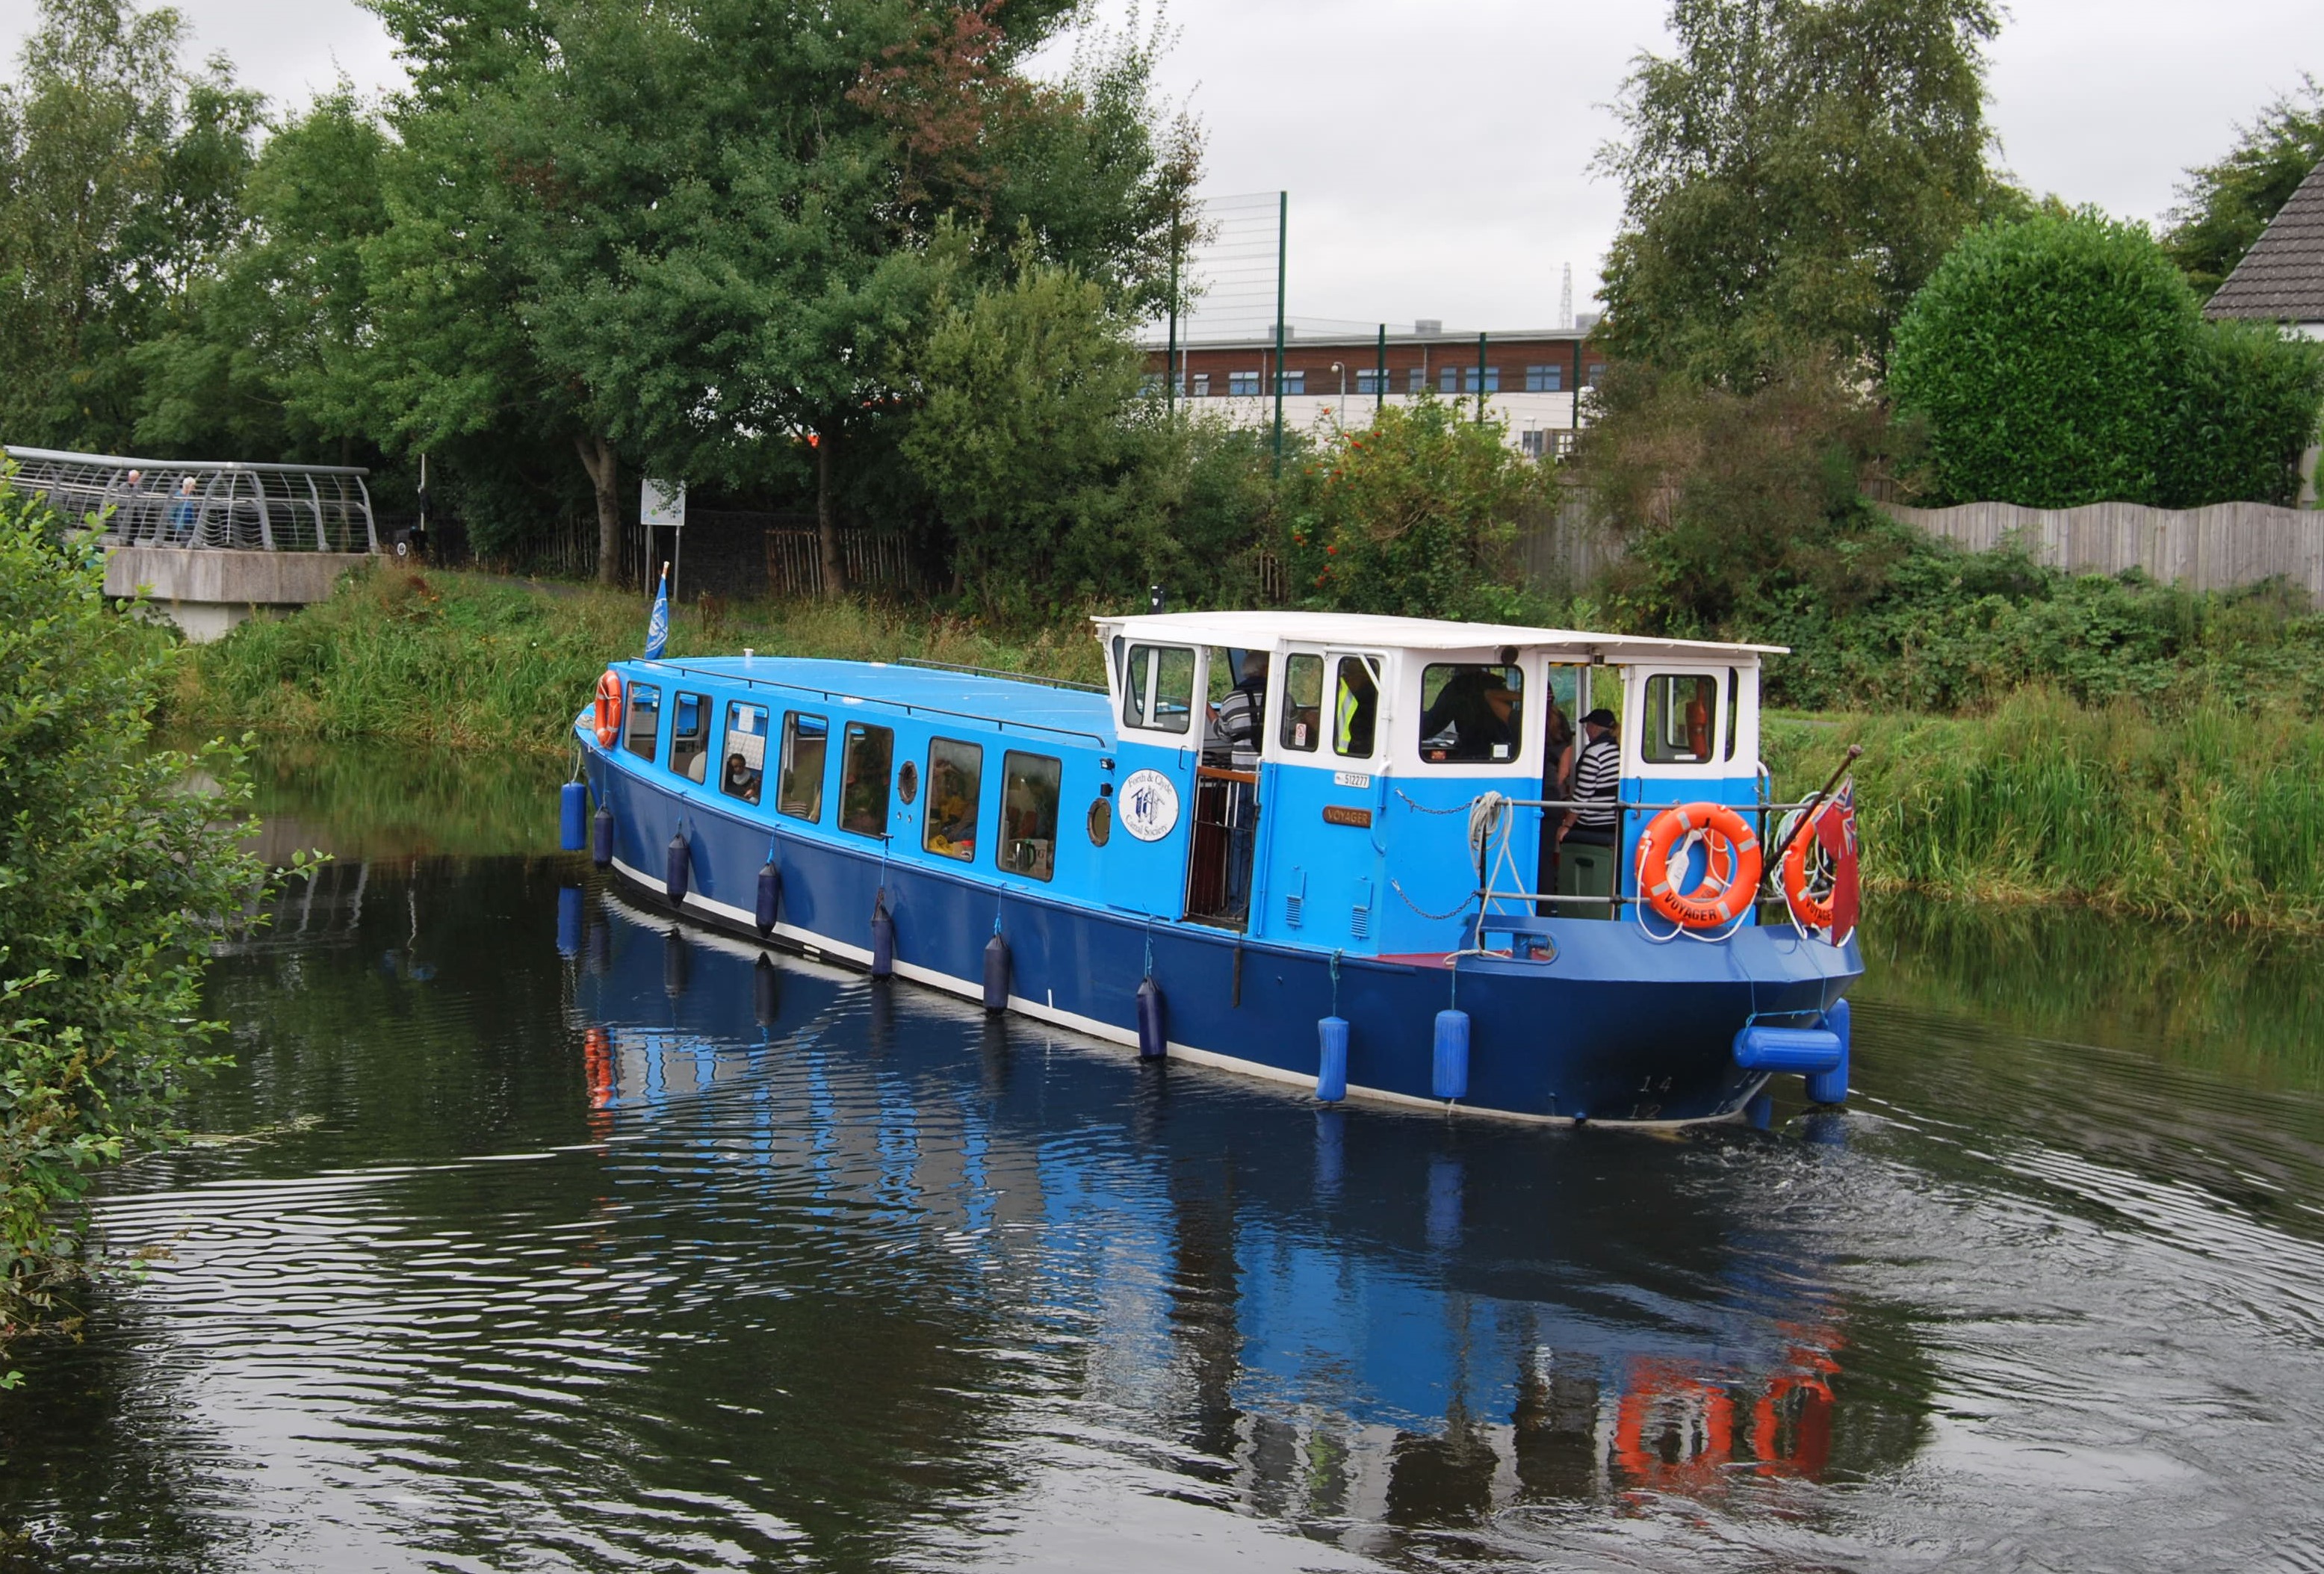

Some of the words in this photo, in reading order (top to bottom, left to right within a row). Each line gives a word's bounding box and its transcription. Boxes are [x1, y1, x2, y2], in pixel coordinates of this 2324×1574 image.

[1128, 772, 1146, 787] Forth
[1147, 772, 1153, 782] &
[1155, 775, 1172, 794] Clyde
[1345, 774, 1368, 787] 512277
[1125, 814, 1143, 834] Canal
[1144, 824, 1168, 836] Society
[1327, 809, 1368, 824] VOYAGER
[1664, 892, 1717, 921] VOYAGER
